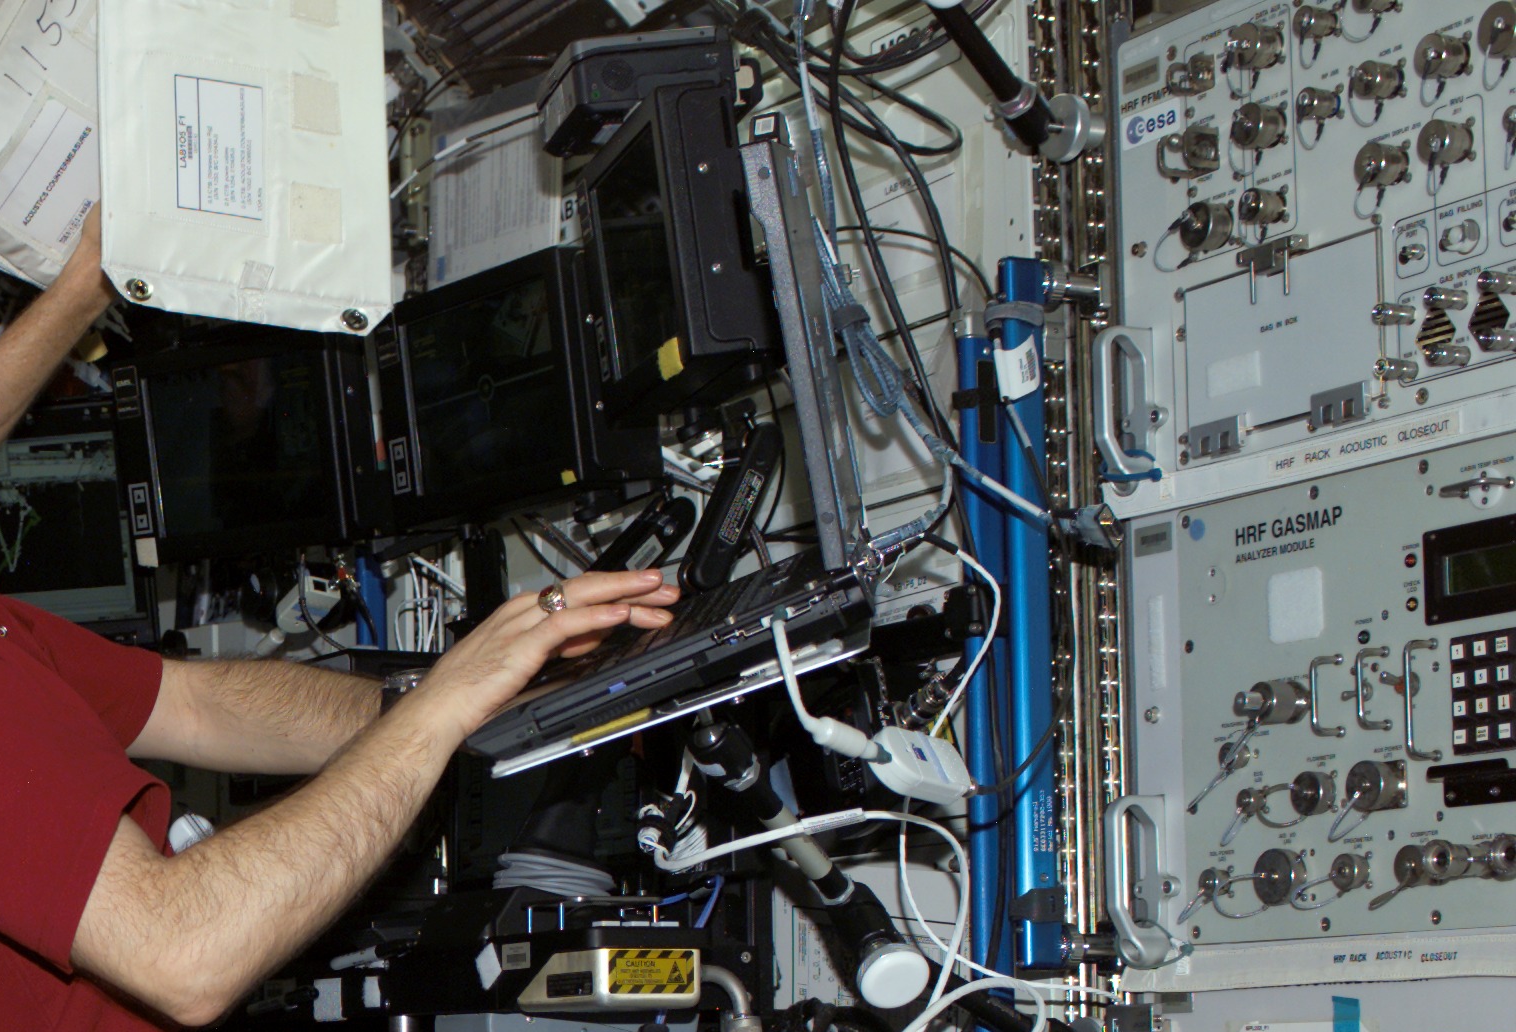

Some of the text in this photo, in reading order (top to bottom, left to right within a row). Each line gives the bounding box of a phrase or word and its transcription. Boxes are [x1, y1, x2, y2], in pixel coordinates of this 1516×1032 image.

[1121, 96, 1140, 114] HRF
[1146, 109, 1176, 133] esa
[22, 191, 49, 227] ACOUSTICS
[45, 126, 93, 192] COUNTERMEASURES
[1439, 200, 1483, 220] BAG FILLING
[1439, 265, 1482, 285] GAS INPUTS
[1276, 419, 1450, 471] HRF RACK ACOUSTIC CLOSEOUT
[1235, 505, 1343, 547] HRF GASMAP
[1236, 538, 1315, 564] ANALYZER MODULE
[1350, 952, 1367, 962] RACK
[1376, 950, 1412, 960] ACOUSTIC
[1420, 951, 1457, 962] CLOSEOUT
